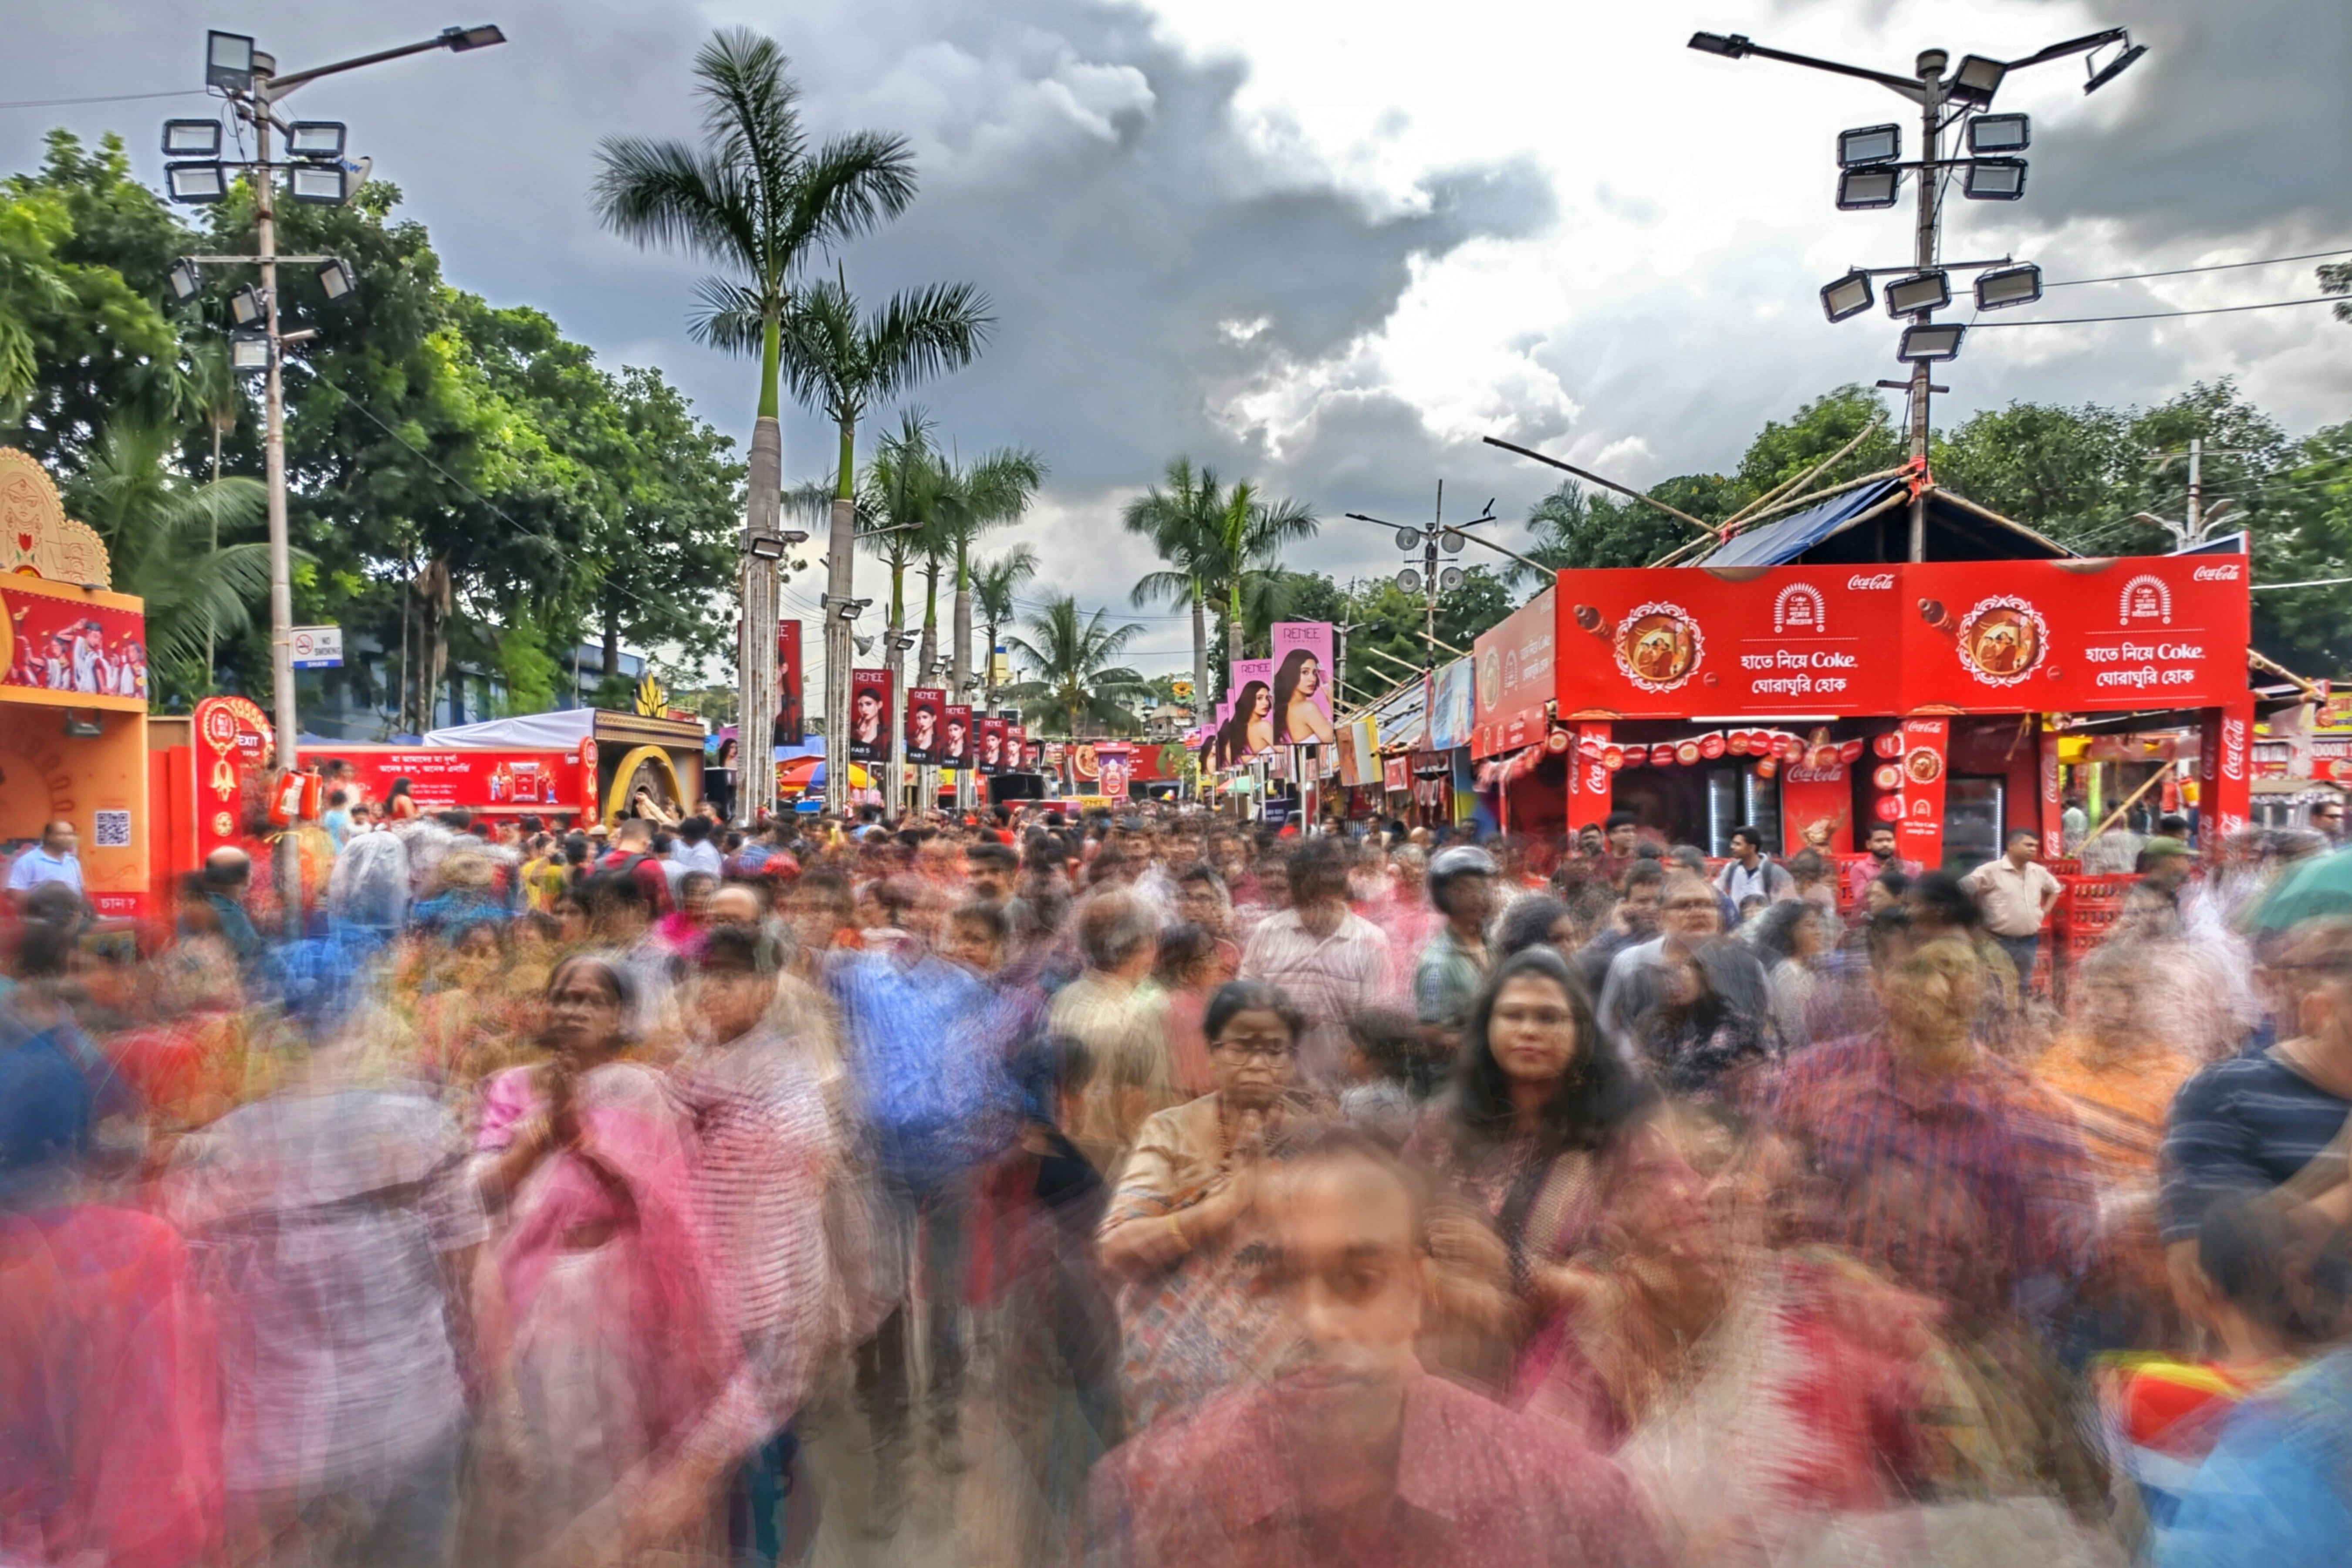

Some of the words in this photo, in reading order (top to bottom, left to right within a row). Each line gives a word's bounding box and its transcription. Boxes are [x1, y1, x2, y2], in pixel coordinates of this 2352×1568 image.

[1848, 574, 1895, 590] Coca-Cola
[2193, 565, 2240, 581] Coca-Cola
[1740, 656, 1774, 669] হাতে
[1777, 650, 1808, 668] নিয়ে
[1811, 652, 1855, 668] Coke
[2085, 648, 2119, 662] হাতে
[2122, 642, 2154, 661] নিয়ে
[2157, 644, 2203, 659] Coke
[1752, 673, 1811, 697] ঘোরাঘুরি
[1815, 678, 1847, 692] হোক
[2096, 666, 2158, 689] ঘোরাঘুরি
[2162, 669, 2194, 685] হোক
[1908, 721, 1942, 733] Coca-Cola
[239, 735, 259, 747] EXIT
[2223, 716, 2244, 780] Coca-Cola
